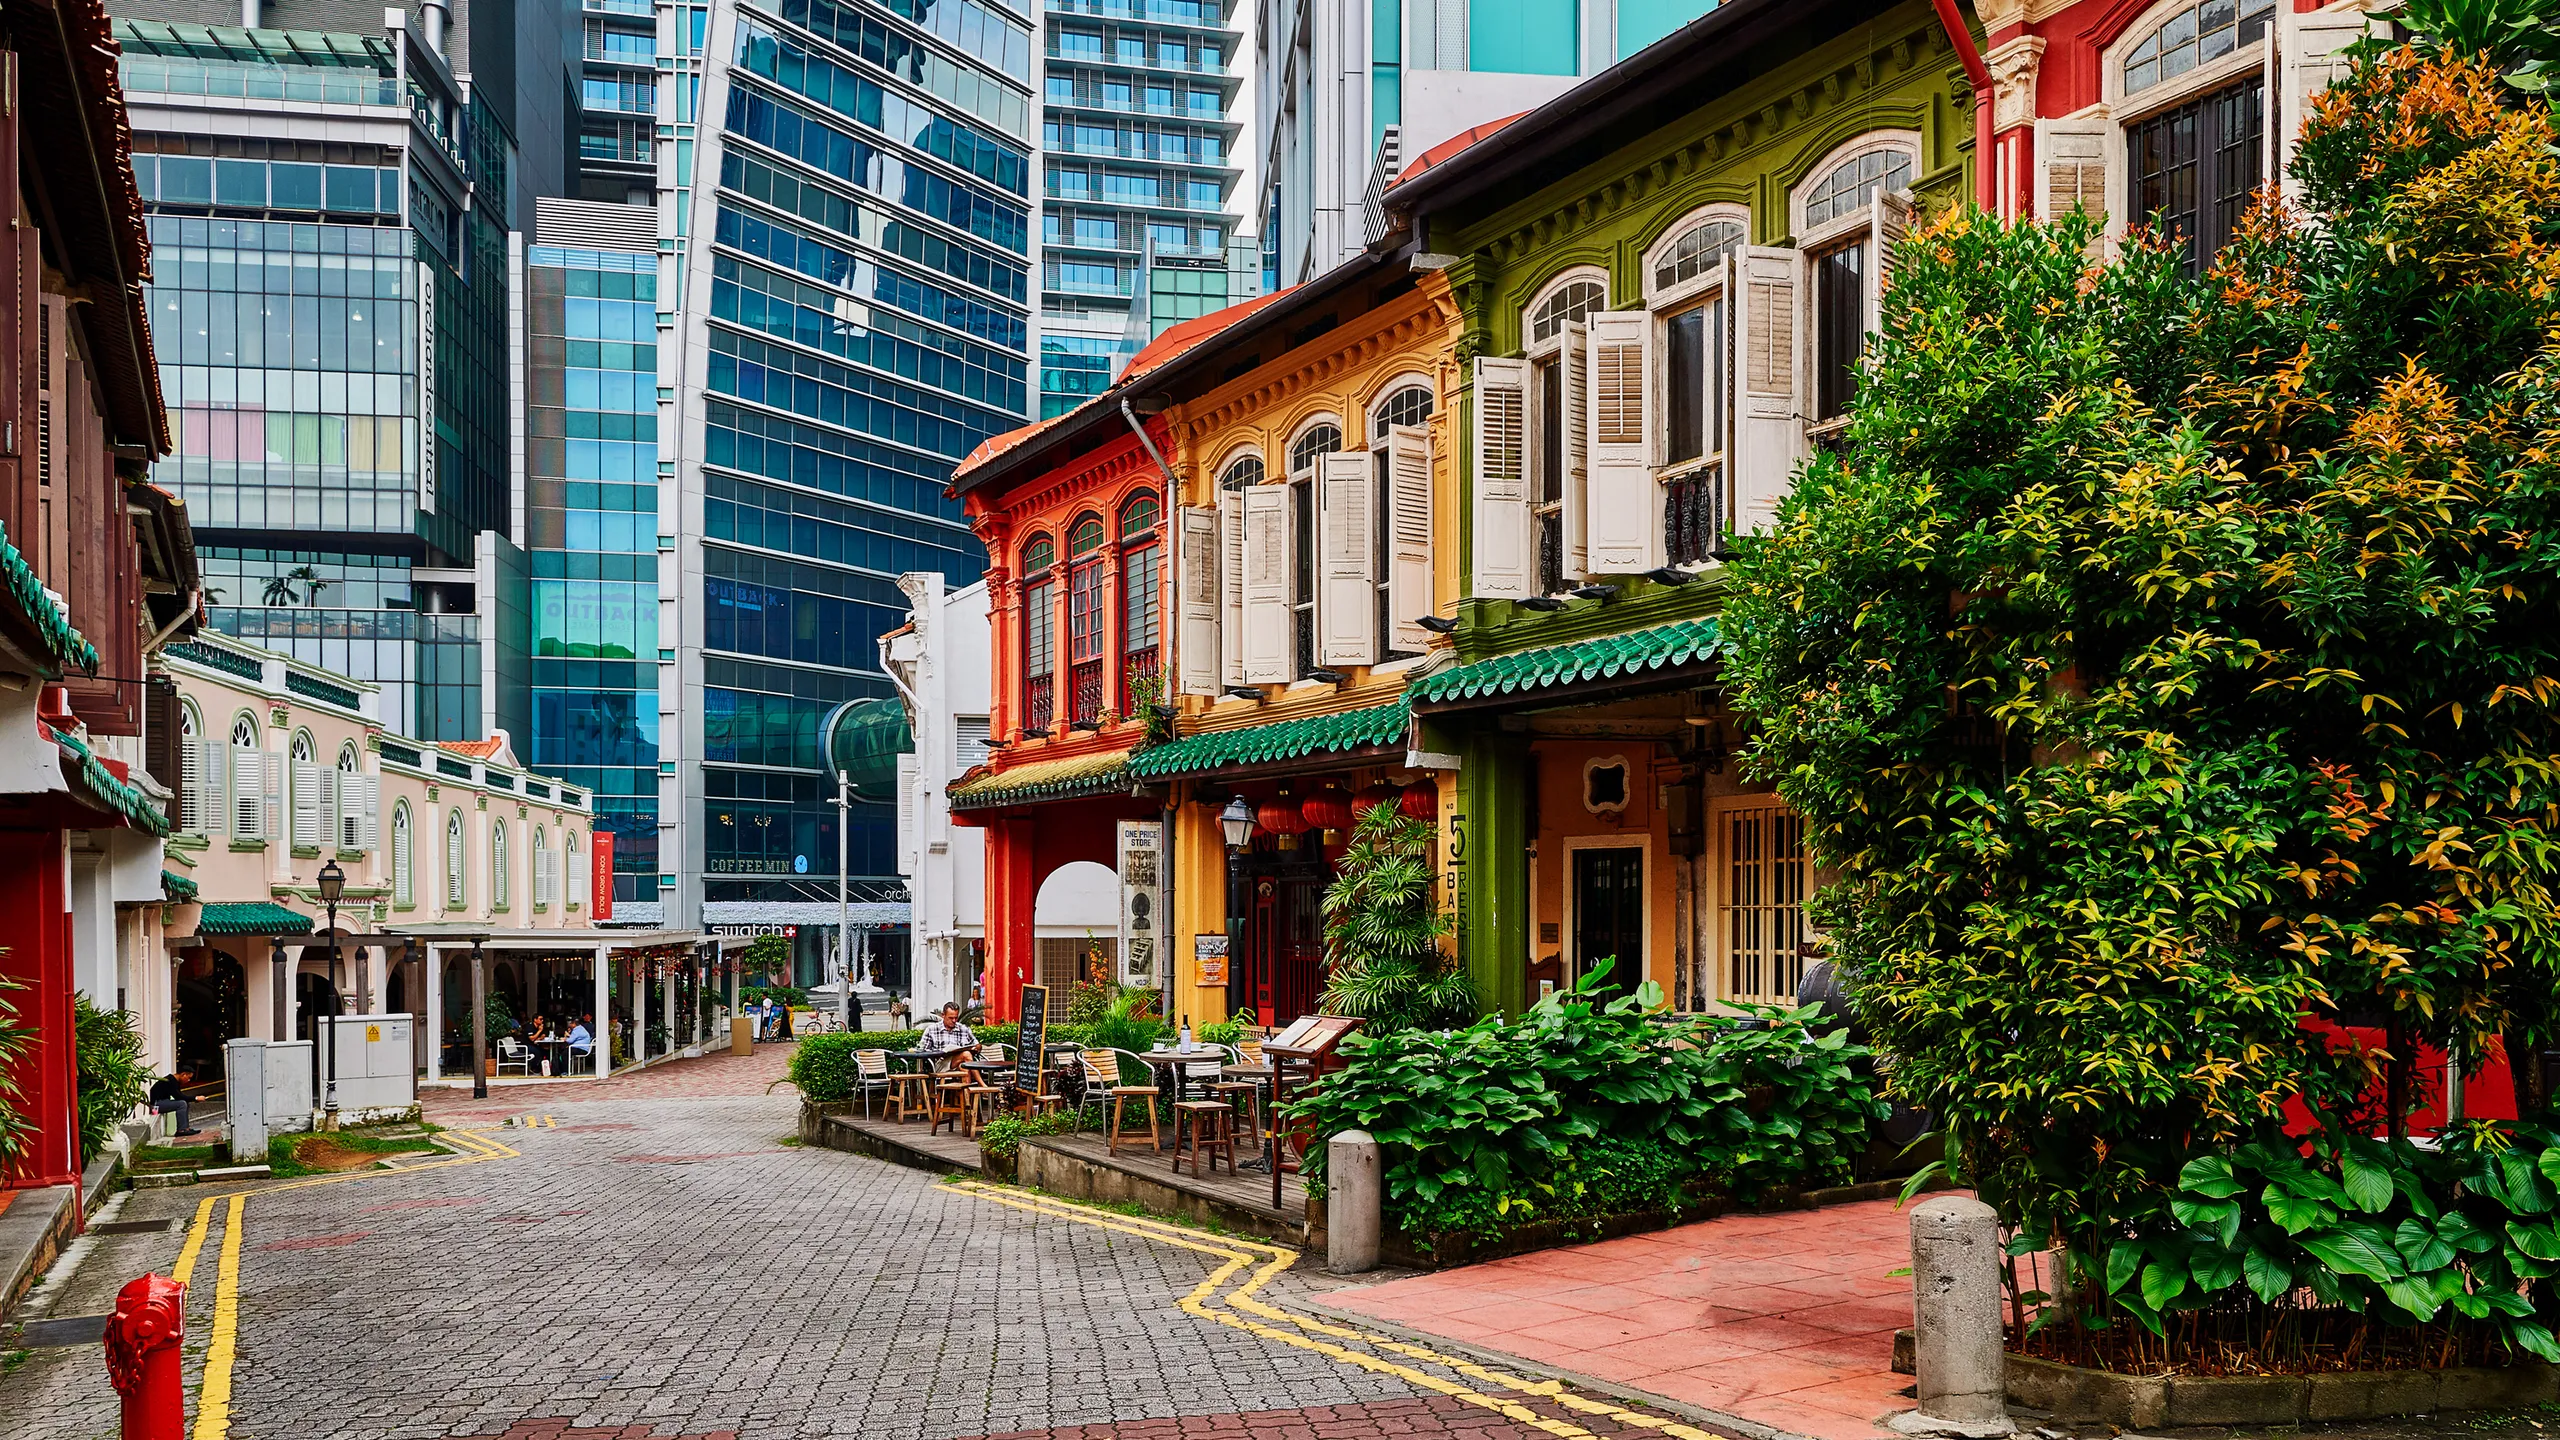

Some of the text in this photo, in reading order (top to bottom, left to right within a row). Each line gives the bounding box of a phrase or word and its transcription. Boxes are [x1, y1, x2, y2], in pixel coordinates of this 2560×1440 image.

[425, 282, 434, 496] orchardcentral
[546, 602, 656, 622] OUTBACK
[1125, 830, 1157, 838] ONE PRICE
[1450, 815, 1466, 858] 5
[1131, 839, 1151, 847] STORE
[712, 924, 784, 938] swatch
